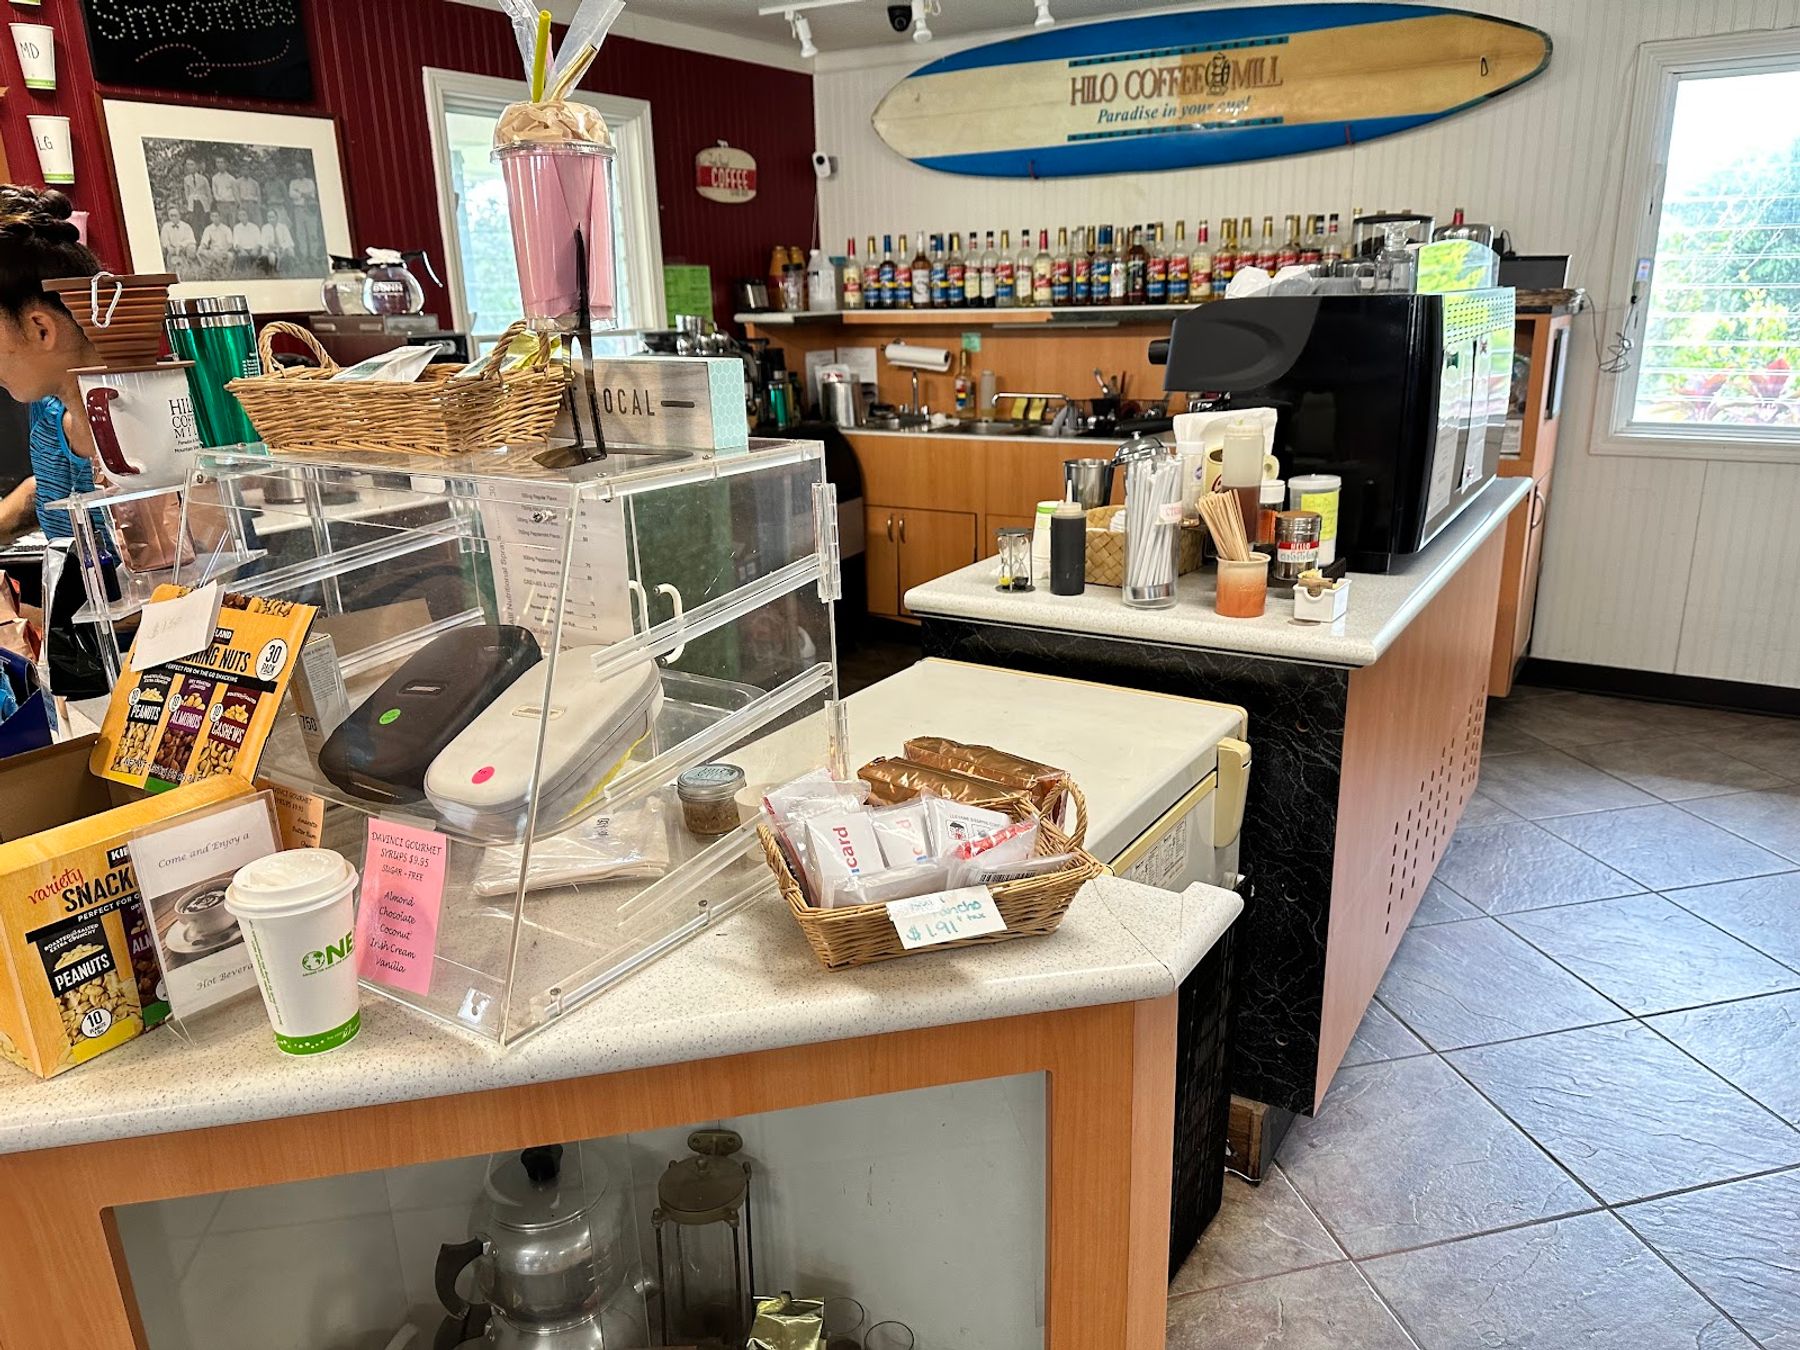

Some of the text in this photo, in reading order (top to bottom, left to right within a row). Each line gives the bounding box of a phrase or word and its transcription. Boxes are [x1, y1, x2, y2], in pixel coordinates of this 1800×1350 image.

[19, 41, 39, 60] MD
[1070, 55, 1284, 106] HILO COFFEE MILL
[1097, 95, 1251, 124] Paradise in your cup!
[37, 135, 53, 152] LG
[711, 167, 748, 189] COFFEE
[602, 387, 656, 417] OCAL
[221, 650, 251, 673] NUTS
[265, 644, 282, 665] 30
[130, 703, 161, 721] PEANUTS
[170, 711, 203, 729] ALMONDS
[211, 722, 245, 744] CASHEWS
[300, 714, 318, 732] 750
[158, 832, 249, 869] Come and Enjoy a
[371, 831, 443, 857] DAVINCI GOURMET
[380, 848, 430, 868] SYRUPS $9.95
[382, 863, 403, 877] SUGAR
[408, 870, 425, 883] FREE
[28, 867, 85, 905] variety
[77, 904, 114, 923] PERFECT
[116, 896, 132, 907] FOR
[384, 891, 415, 908] Almond
[378, 906, 416, 925] Chocolate
[379, 923, 412, 941] Coconut
[369, 938, 417, 960] Irish Cream
[54, 953, 111, 991] PEANUTS
[375, 956, 406, 974] Vanilla
[196, 963, 253, 991] Hot Bevera
[87, 1010, 103, 1028] 10
